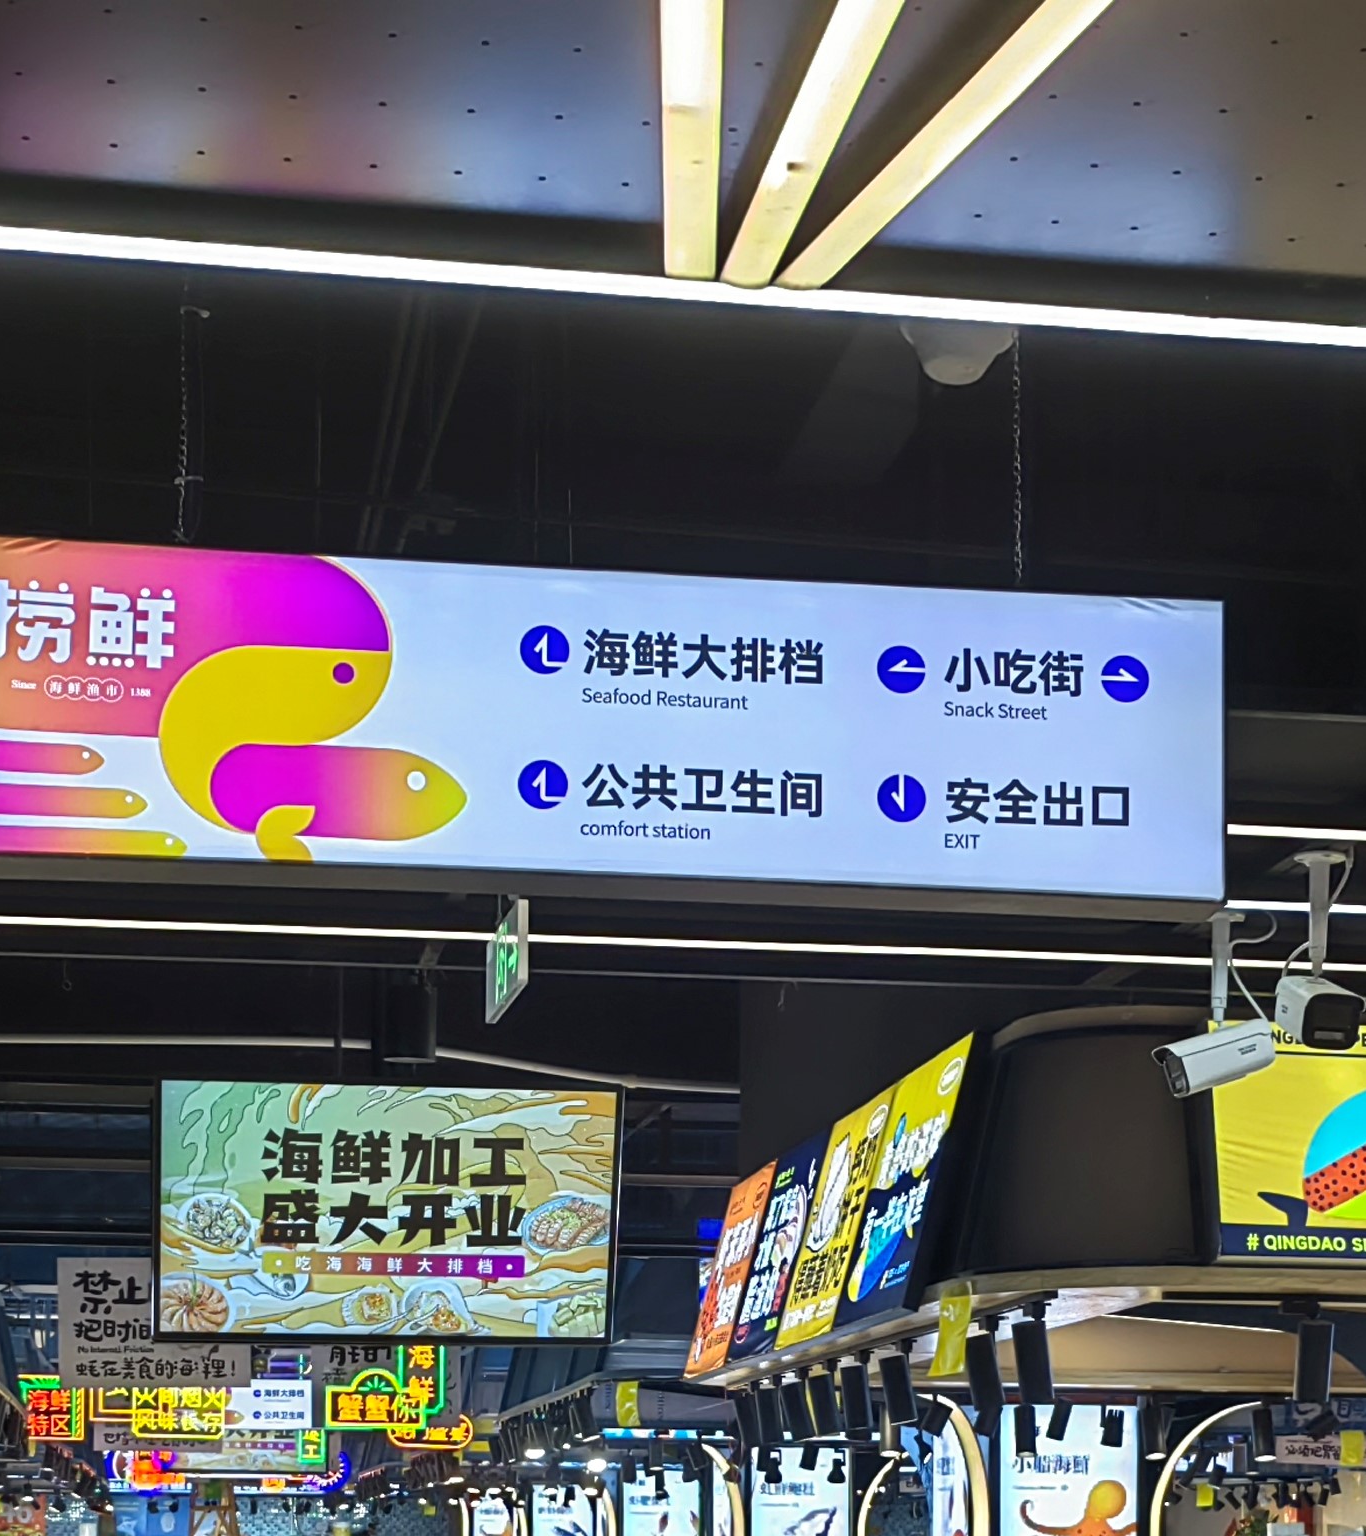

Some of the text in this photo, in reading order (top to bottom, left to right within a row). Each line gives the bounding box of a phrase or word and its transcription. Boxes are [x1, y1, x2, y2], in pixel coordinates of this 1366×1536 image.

[583, 628, 824, 685] 海鲜大排档
[944, 647, 1084, 697] 小吃街
[11, 679, 37, 690] Since
[582, 687, 748, 710] Seafood Restaurant
[944, 701, 1048, 720] Snack Street
[582, 763, 823, 818] 公共卫生间
[946, 777, 1130, 827] 安全出口
[580, 820, 711, 840] comfort station
[944, 833, 981, 850] EXIT
[261, 1127, 527, 1188] 海鲜加工
[260, 1189, 526, 1248] 盛大开业
[1263, 1234, 1347, 1253] QINGDAO
[295, 1255, 494, 1275] 吃海海鲜大排档
[72, 1269, 152, 1315] 禁止
[27, 1389, 72, 1411] 海鲜
[27, 1414, 72, 1437] 特区
